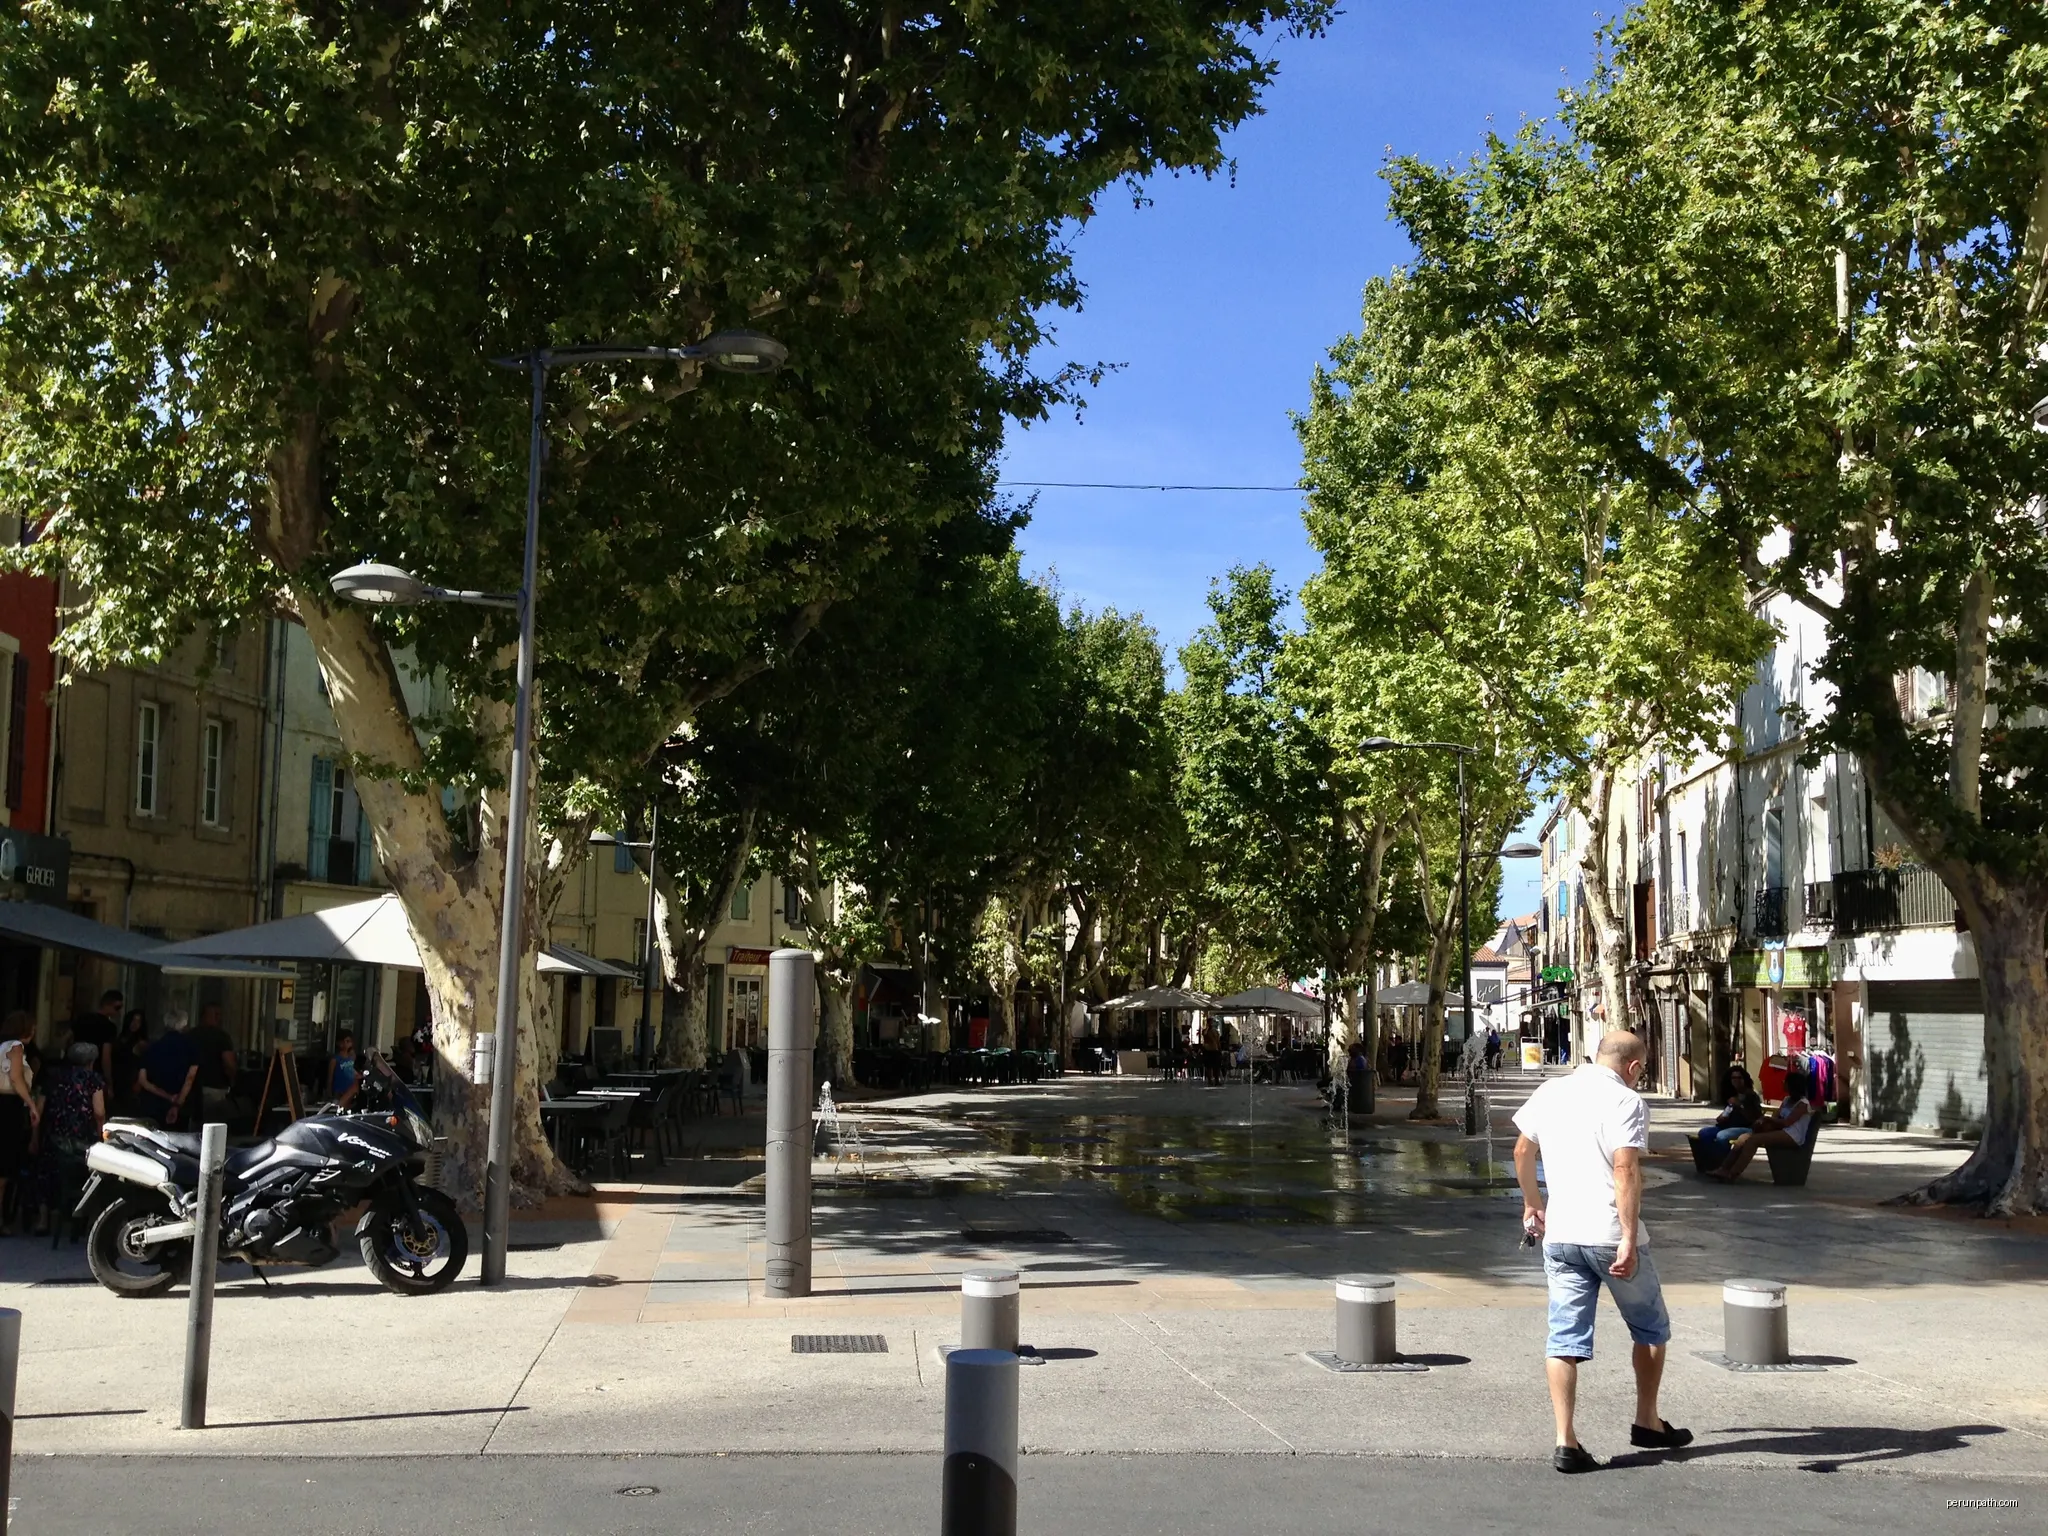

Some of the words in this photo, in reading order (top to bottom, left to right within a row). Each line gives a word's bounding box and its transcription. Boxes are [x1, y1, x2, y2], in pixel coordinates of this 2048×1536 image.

[26, 866, 56, 887] GLACIER
[732, 950, 762, 962] Traiteur
[1840, 943, 1894, 968] Paradise
